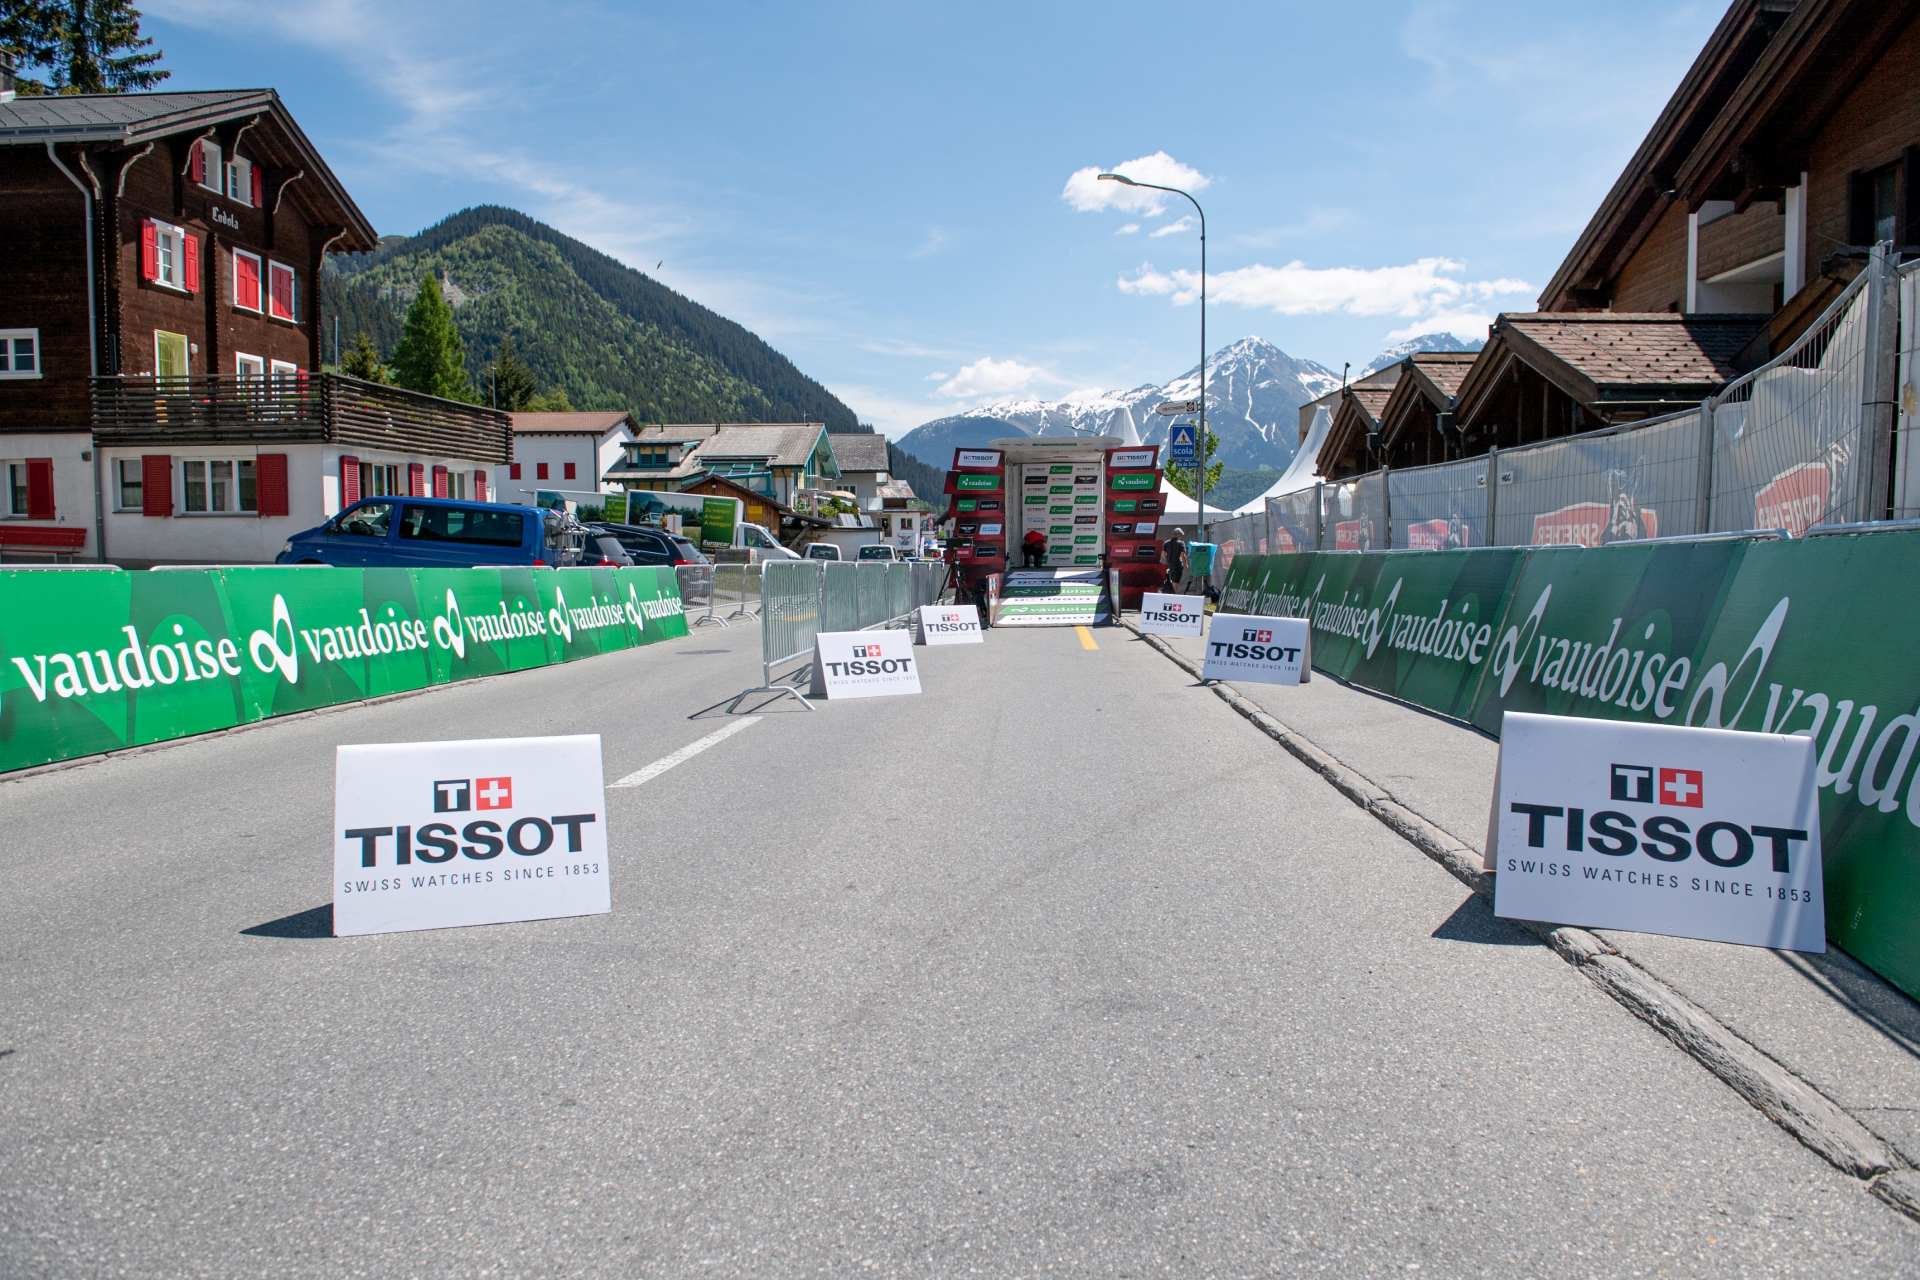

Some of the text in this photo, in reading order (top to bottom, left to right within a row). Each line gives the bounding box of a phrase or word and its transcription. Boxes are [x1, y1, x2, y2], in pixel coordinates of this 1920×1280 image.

[464, 595, 547, 644] vaudoise
[568, 588, 626, 626] vaudoise
[640, 582, 683, 616] vaudoise
[1144, 612, 1200, 623] TISSOT
[1259, 583, 1300, 618] vaudoise
[1312, 591, 1367, 638] vaudoise
[300, 608, 429, 664] vaudoise
[926, 623, 977, 632] TISSOT
[1387, 598, 1492, 665] vaudoise
[11, 624, 242, 702] vaudoise
[826, 658, 911, 676] TISSOT
[1211, 642, 1300, 662] TISSOT
[1530, 617, 1692, 718] vaudoise
[345, 813, 596, 868] TISSOT
[1510, 802, 1808, 874] TISSOT
[343, 863, 600, 893] SWISS WATCHES SINCE 1853
[1508, 858, 1812, 904] SWISS WATCHES SINCE 1853
